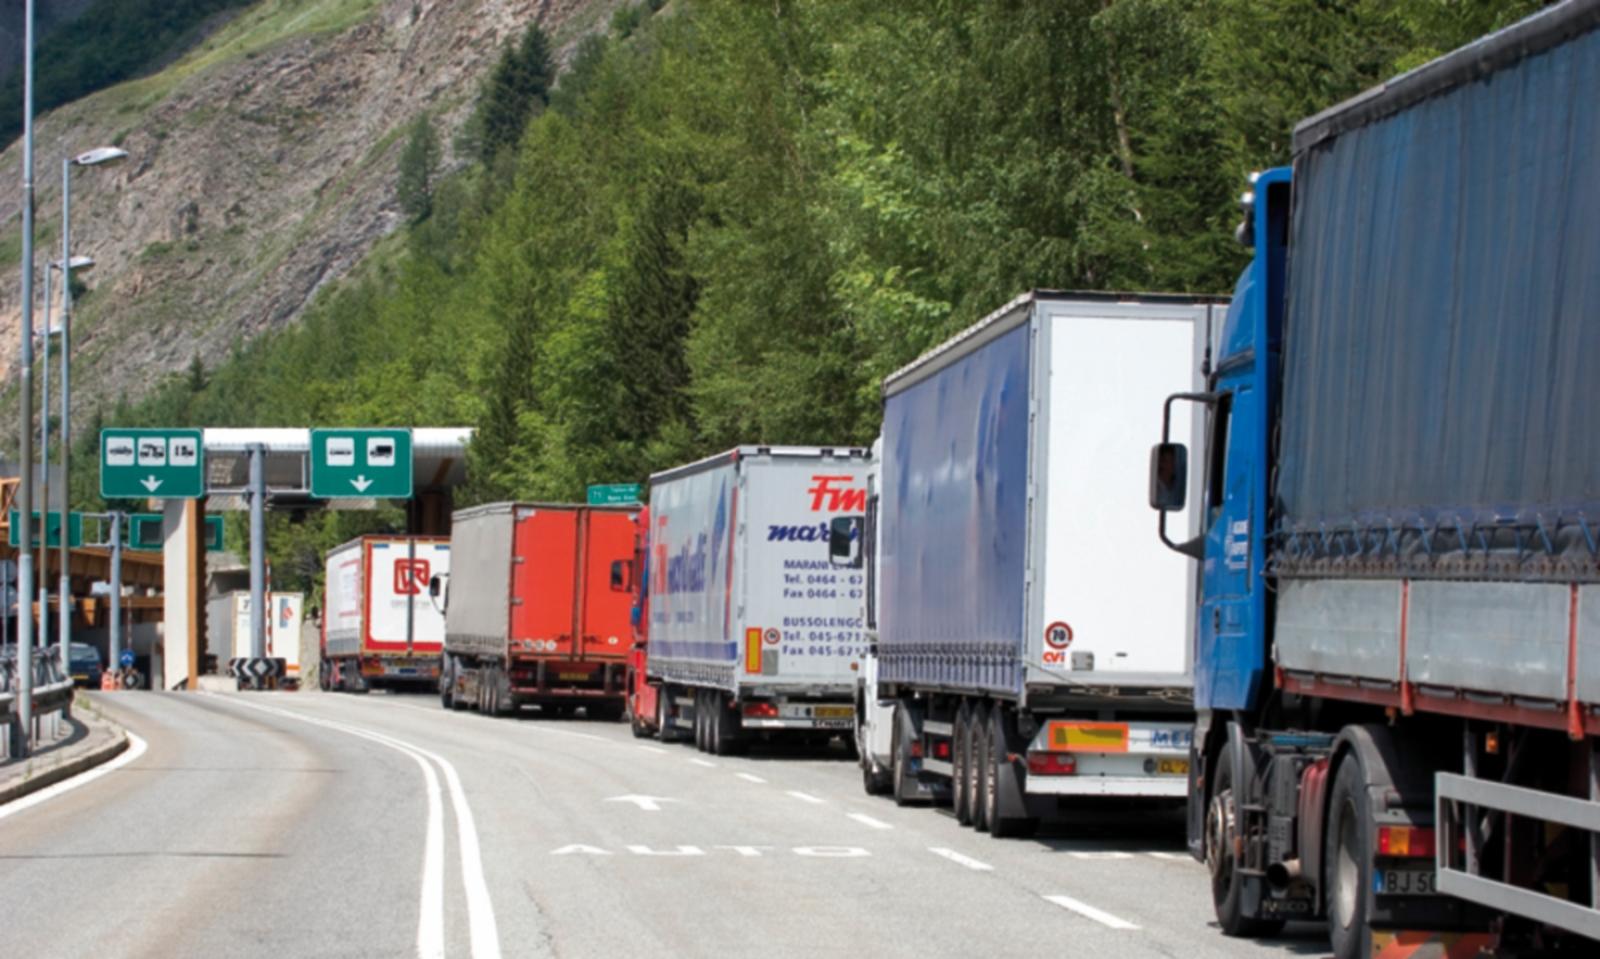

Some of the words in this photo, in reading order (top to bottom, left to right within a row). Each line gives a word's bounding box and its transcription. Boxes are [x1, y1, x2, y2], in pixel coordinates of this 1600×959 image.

[783, 588, 804, 598] Fax
[782, 645, 804, 655] Fax
[549, 843, 872, 858] AUTO
[1387, 872, 1411, 892] BJ
